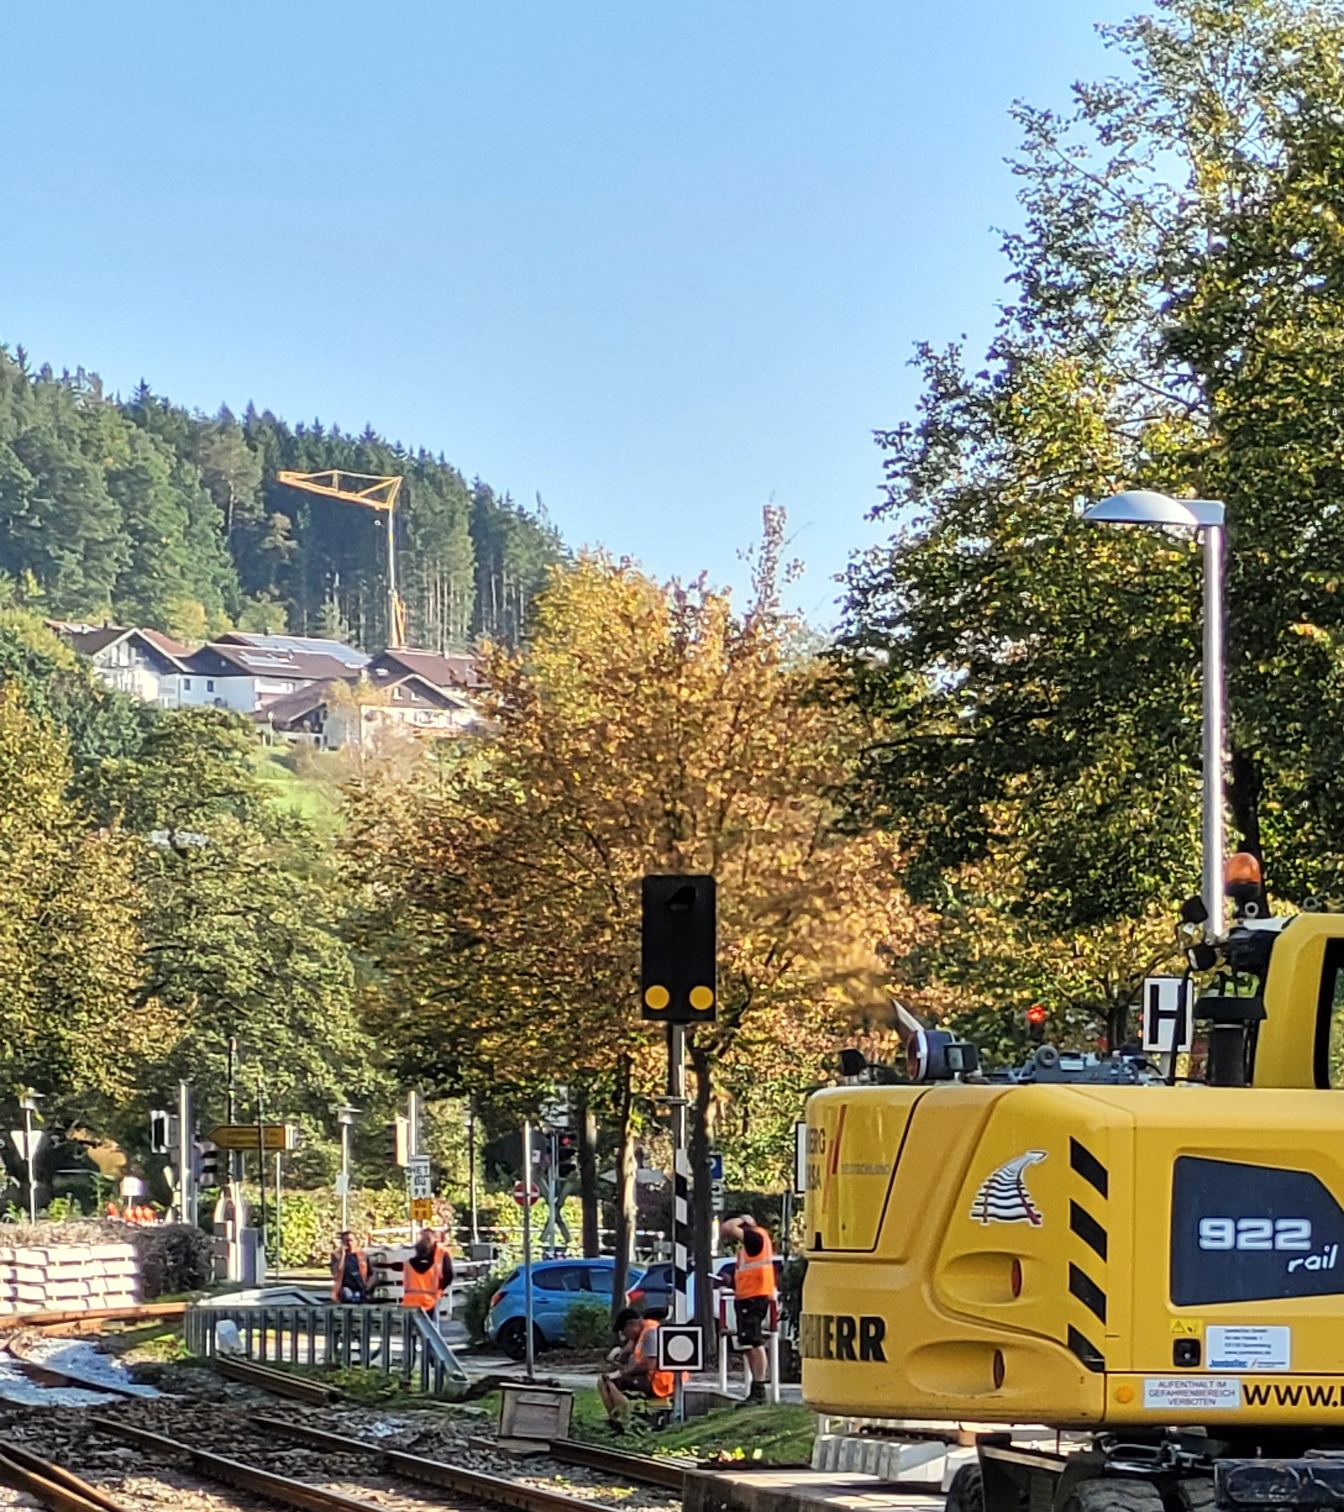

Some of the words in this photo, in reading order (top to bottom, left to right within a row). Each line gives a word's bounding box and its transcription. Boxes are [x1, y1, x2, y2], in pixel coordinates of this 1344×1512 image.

[1148, 984, 1187, 1046] H
[1198, 1217, 1312, 1251] 922
[1287, 1244, 1339, 1273] rail
[800, 1313, 889, 1364] HERR
[1168, 1397, 1217, 1407] VERBOTEN
